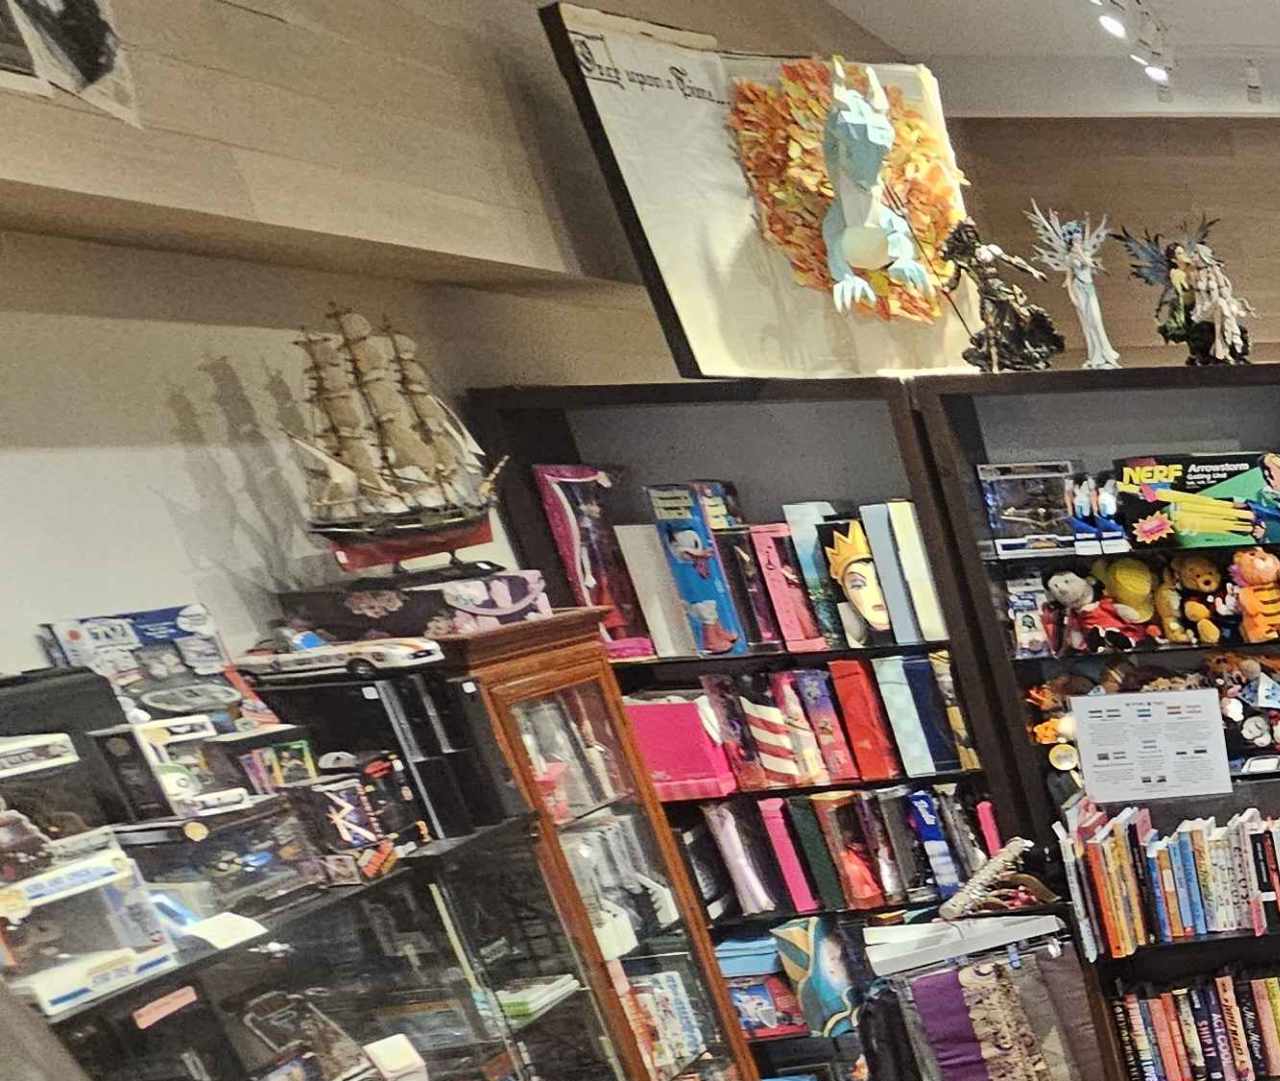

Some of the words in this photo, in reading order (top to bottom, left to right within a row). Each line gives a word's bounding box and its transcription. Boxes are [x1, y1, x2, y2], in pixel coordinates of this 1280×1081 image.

[1122, 463, 1183, 486] NERF
[1197, 1019, 1213, 1046] SHIP
[1211, 1012, 1226, 1035] ACT
[1216, 1035, 1232, 1067] COOL
